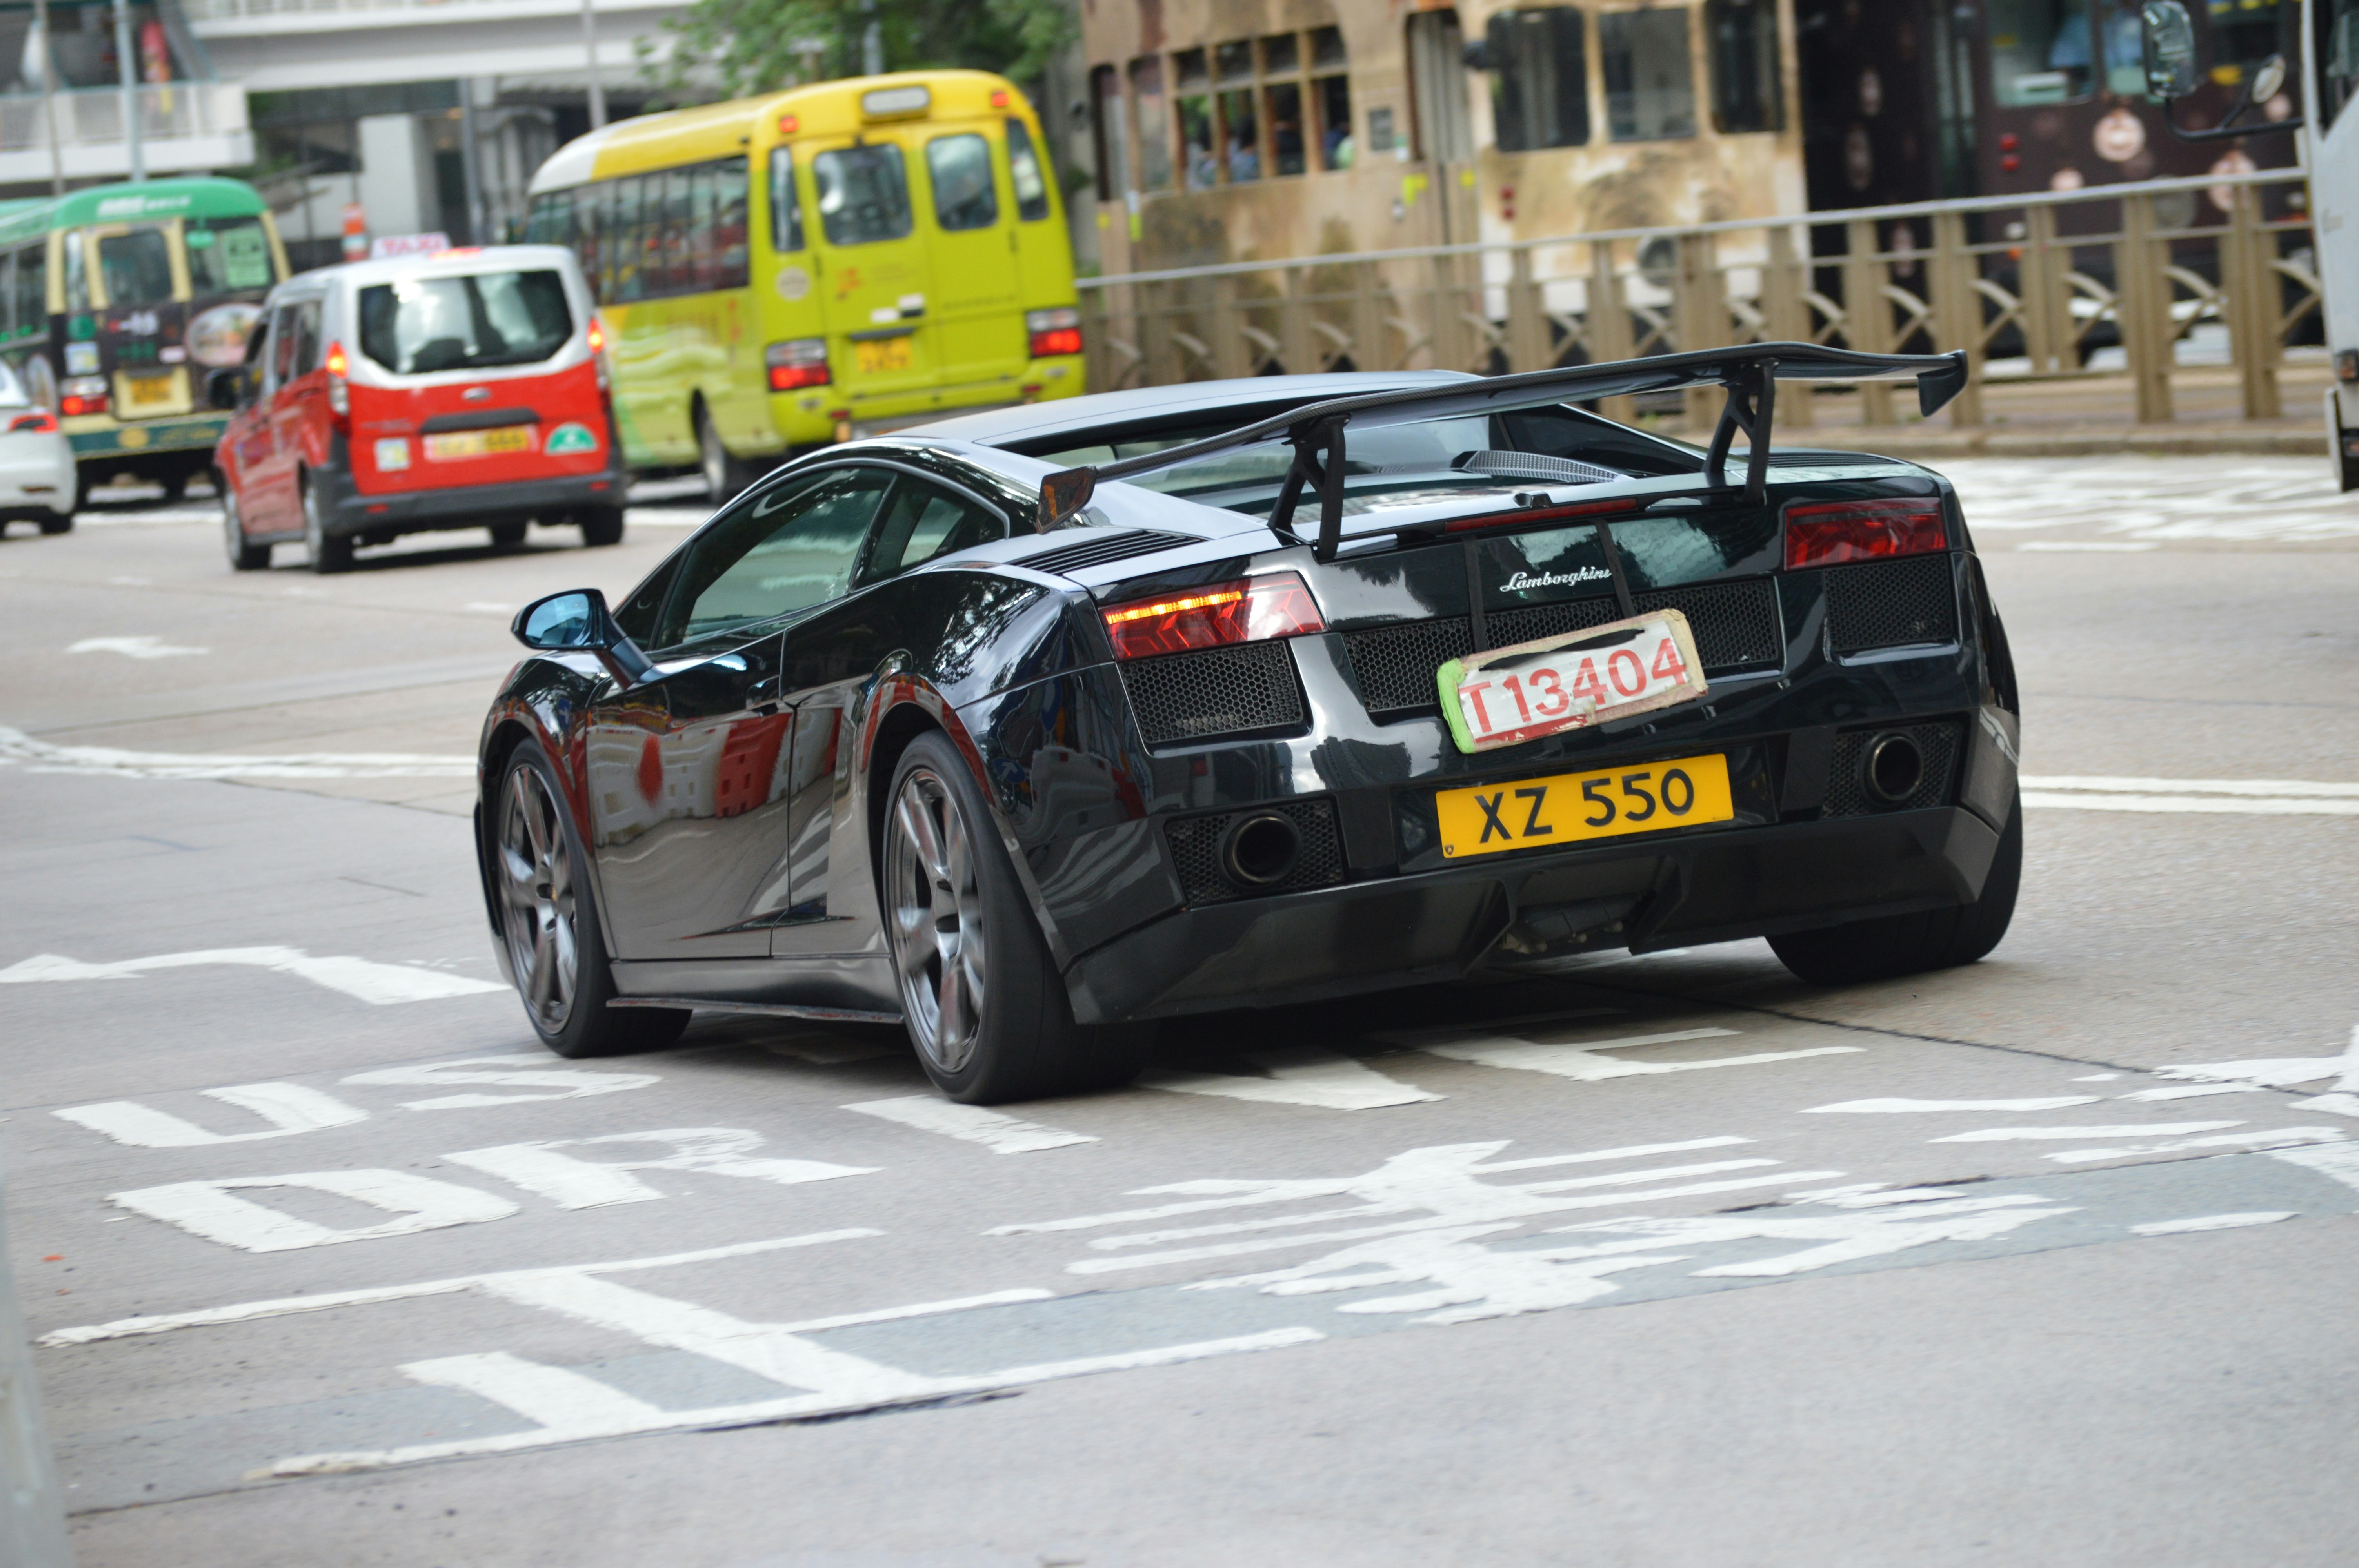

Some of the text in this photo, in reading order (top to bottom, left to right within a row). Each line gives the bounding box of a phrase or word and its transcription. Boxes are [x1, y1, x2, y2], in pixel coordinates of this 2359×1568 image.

[380, 236, 443, 256] TAXI
[1499, 566, 1612, 592] Lamborghini
[1459, 637, 1687, 733] T13404
[1473, 768, 1694, 844] XZ 550
